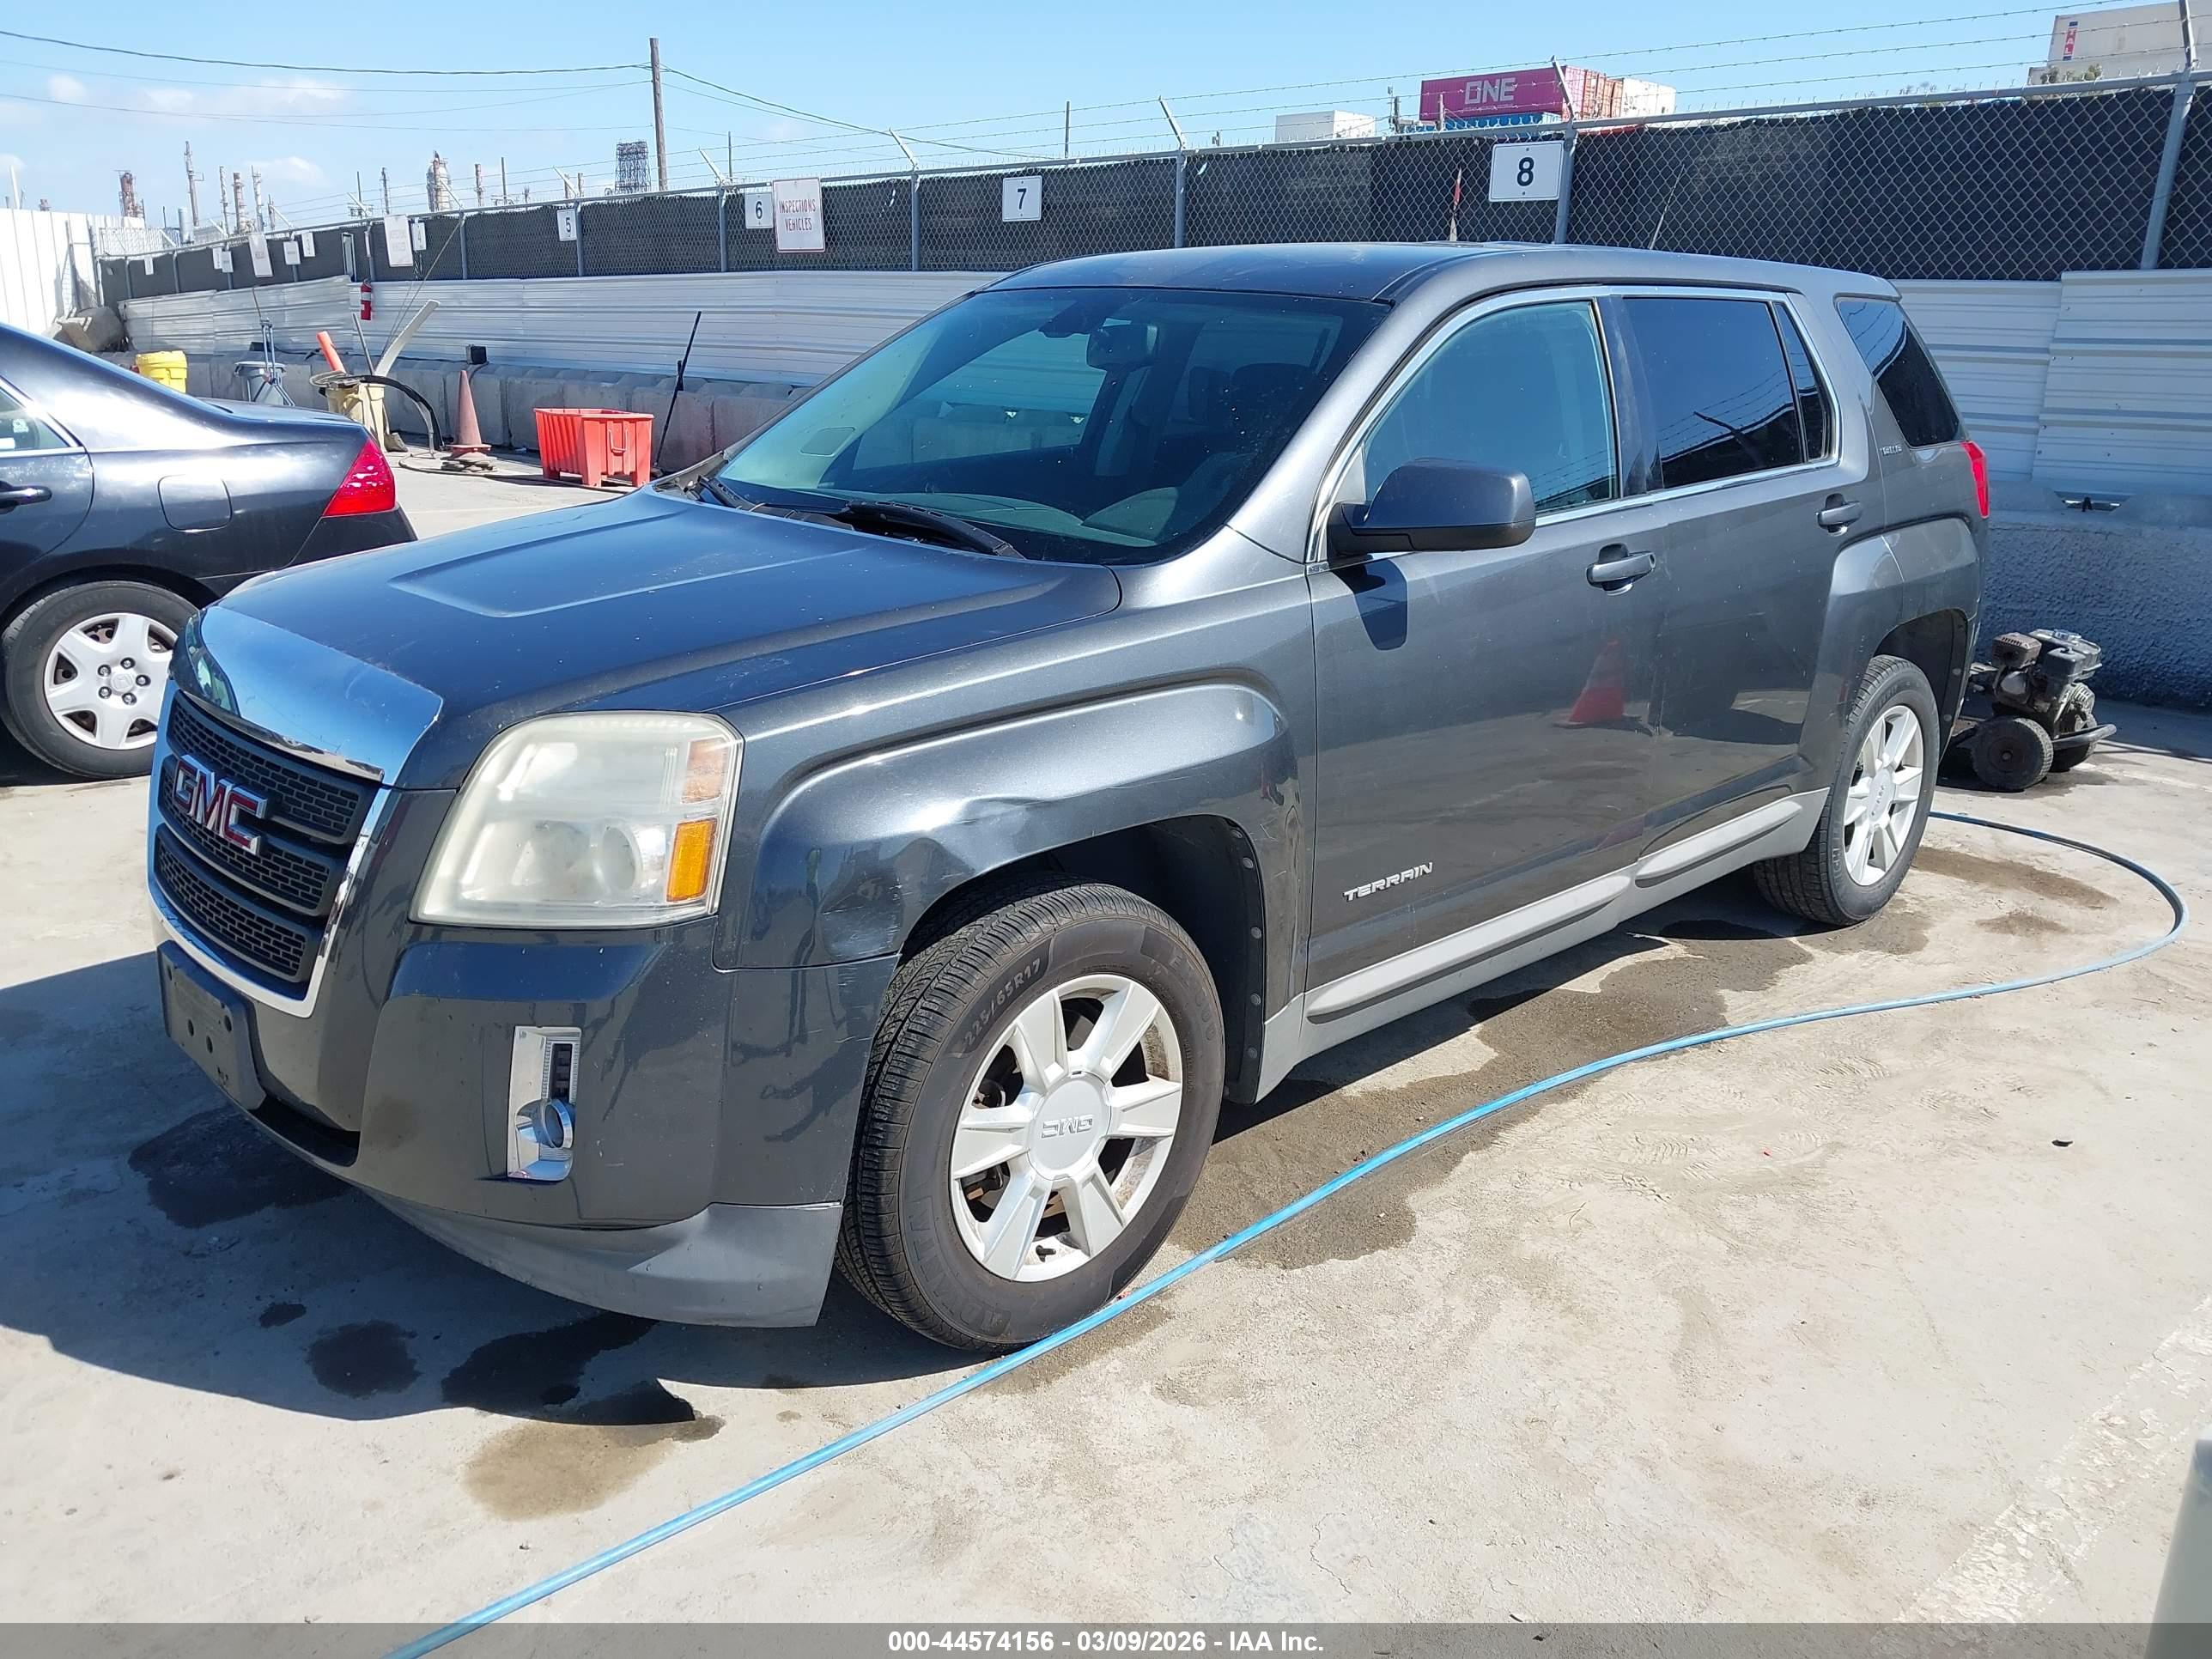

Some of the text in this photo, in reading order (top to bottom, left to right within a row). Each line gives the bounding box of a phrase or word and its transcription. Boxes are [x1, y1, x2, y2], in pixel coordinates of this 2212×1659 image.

[1464, 77, 1517, 104] ONE
[1516, 156, 1534, 187] 8
[755, 200, 763, 220] 6
[778, 198, 817, 214] INSPECTIONS
[1017, 188, 1027, 210] 7
[565, 216, 572, 233] 5
[784, 217, 812, 232] VEHICLES
[173, 754, 268, 857] GMC
[1342, 861, 1433, 902] TERRAIN
[963, 957, 1042, 1047] 225/65R17
[1040, 1114, 1094, 1139] GMC
